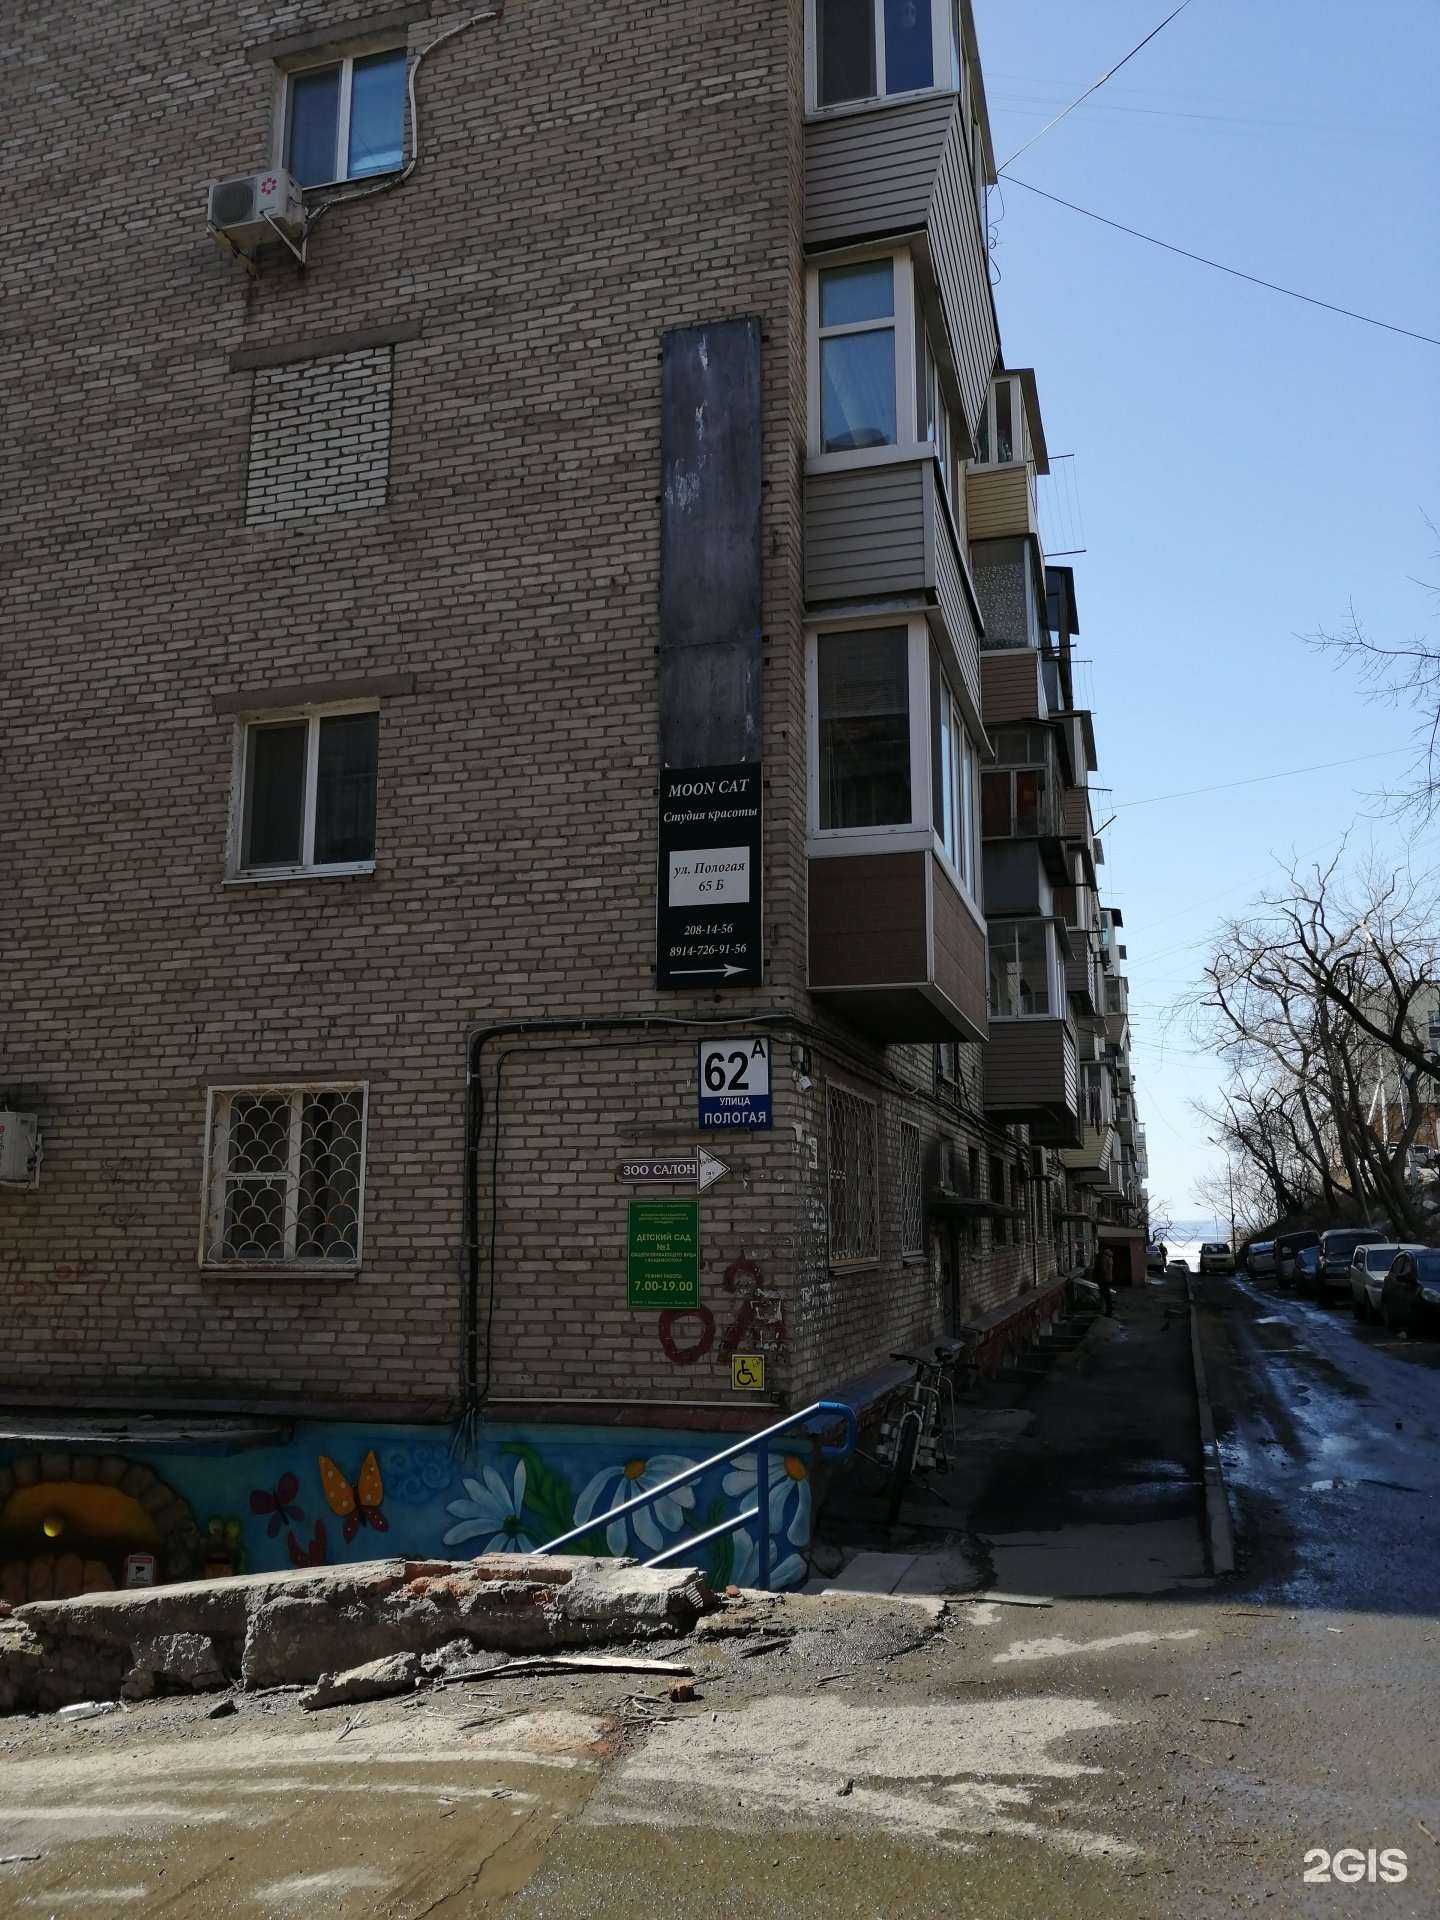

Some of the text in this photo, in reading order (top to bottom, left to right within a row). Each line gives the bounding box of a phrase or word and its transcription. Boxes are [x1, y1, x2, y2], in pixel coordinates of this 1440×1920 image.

[668, 778, 750, 798] MOON CAT
[664, 807, 758, 824] Студия красоты
[674, 862, 746, 879] ул. Пологая
[698, 879, 724, 892] 65 Б
[684, 923, 734, 936] 208-14-56
[669, 943, 747, 957] 8914-726-91-56
[719, 1097, 751, 1106] УЛИЦА
[704, 1111, 766, 1124] ПОЛОГАЯ
[623, 1163, 696, 1175] ЗОО САЛОН
[636, 1232, 692, 1242] ДЕТСКИЙ САД
[634, 1280, 693, 1291] 7.00-19.00
